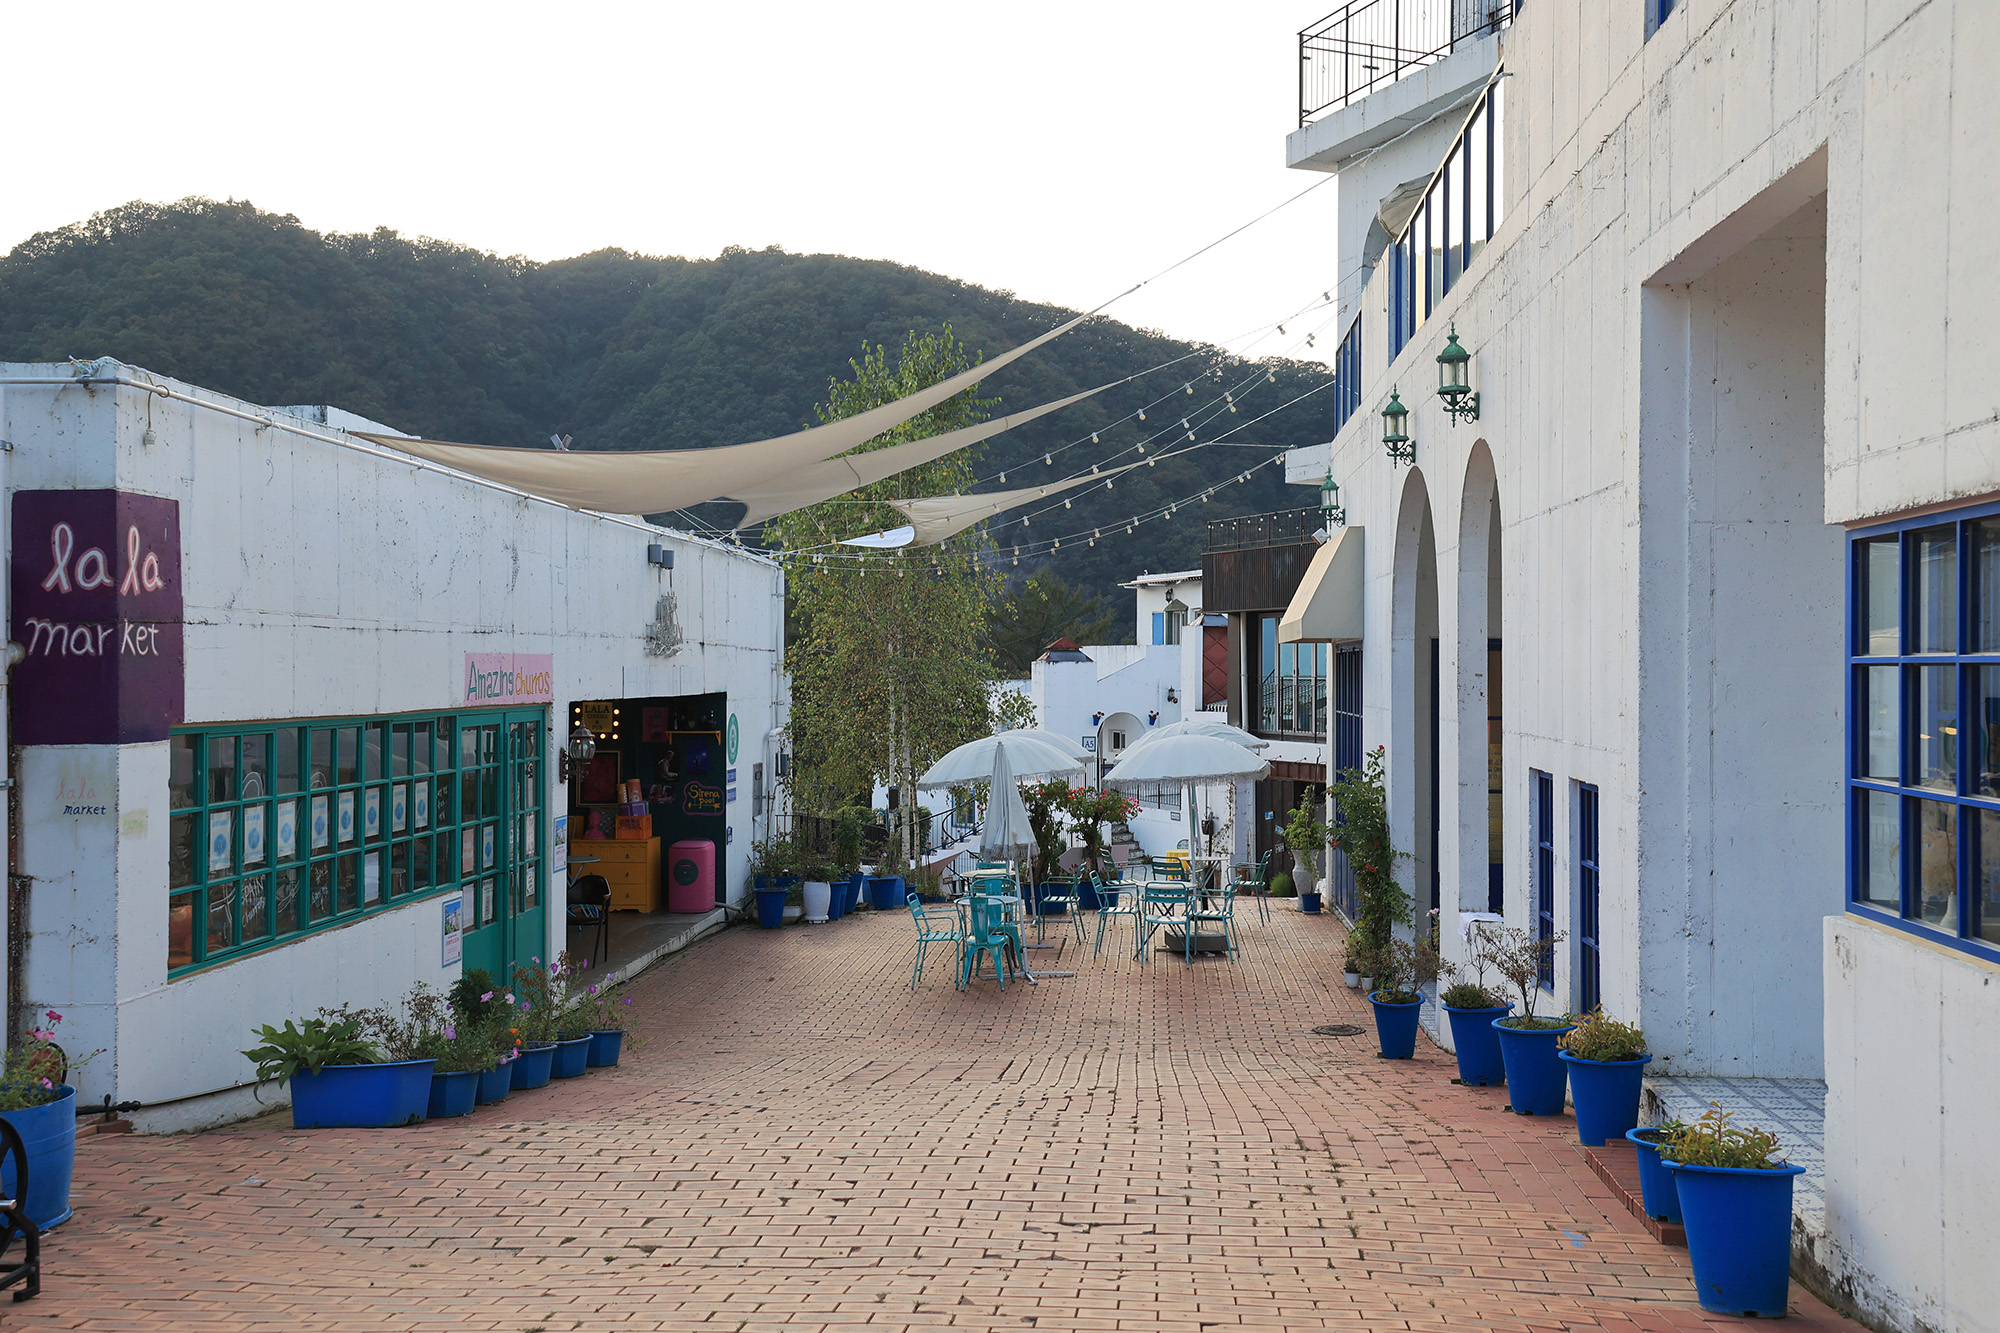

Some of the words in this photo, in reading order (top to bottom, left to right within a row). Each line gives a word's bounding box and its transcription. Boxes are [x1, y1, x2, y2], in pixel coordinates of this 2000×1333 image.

[585, 705, 610, 714] LALA
[1085, 740, 1094, 748] A5
[63, 804, 106, 816] market
